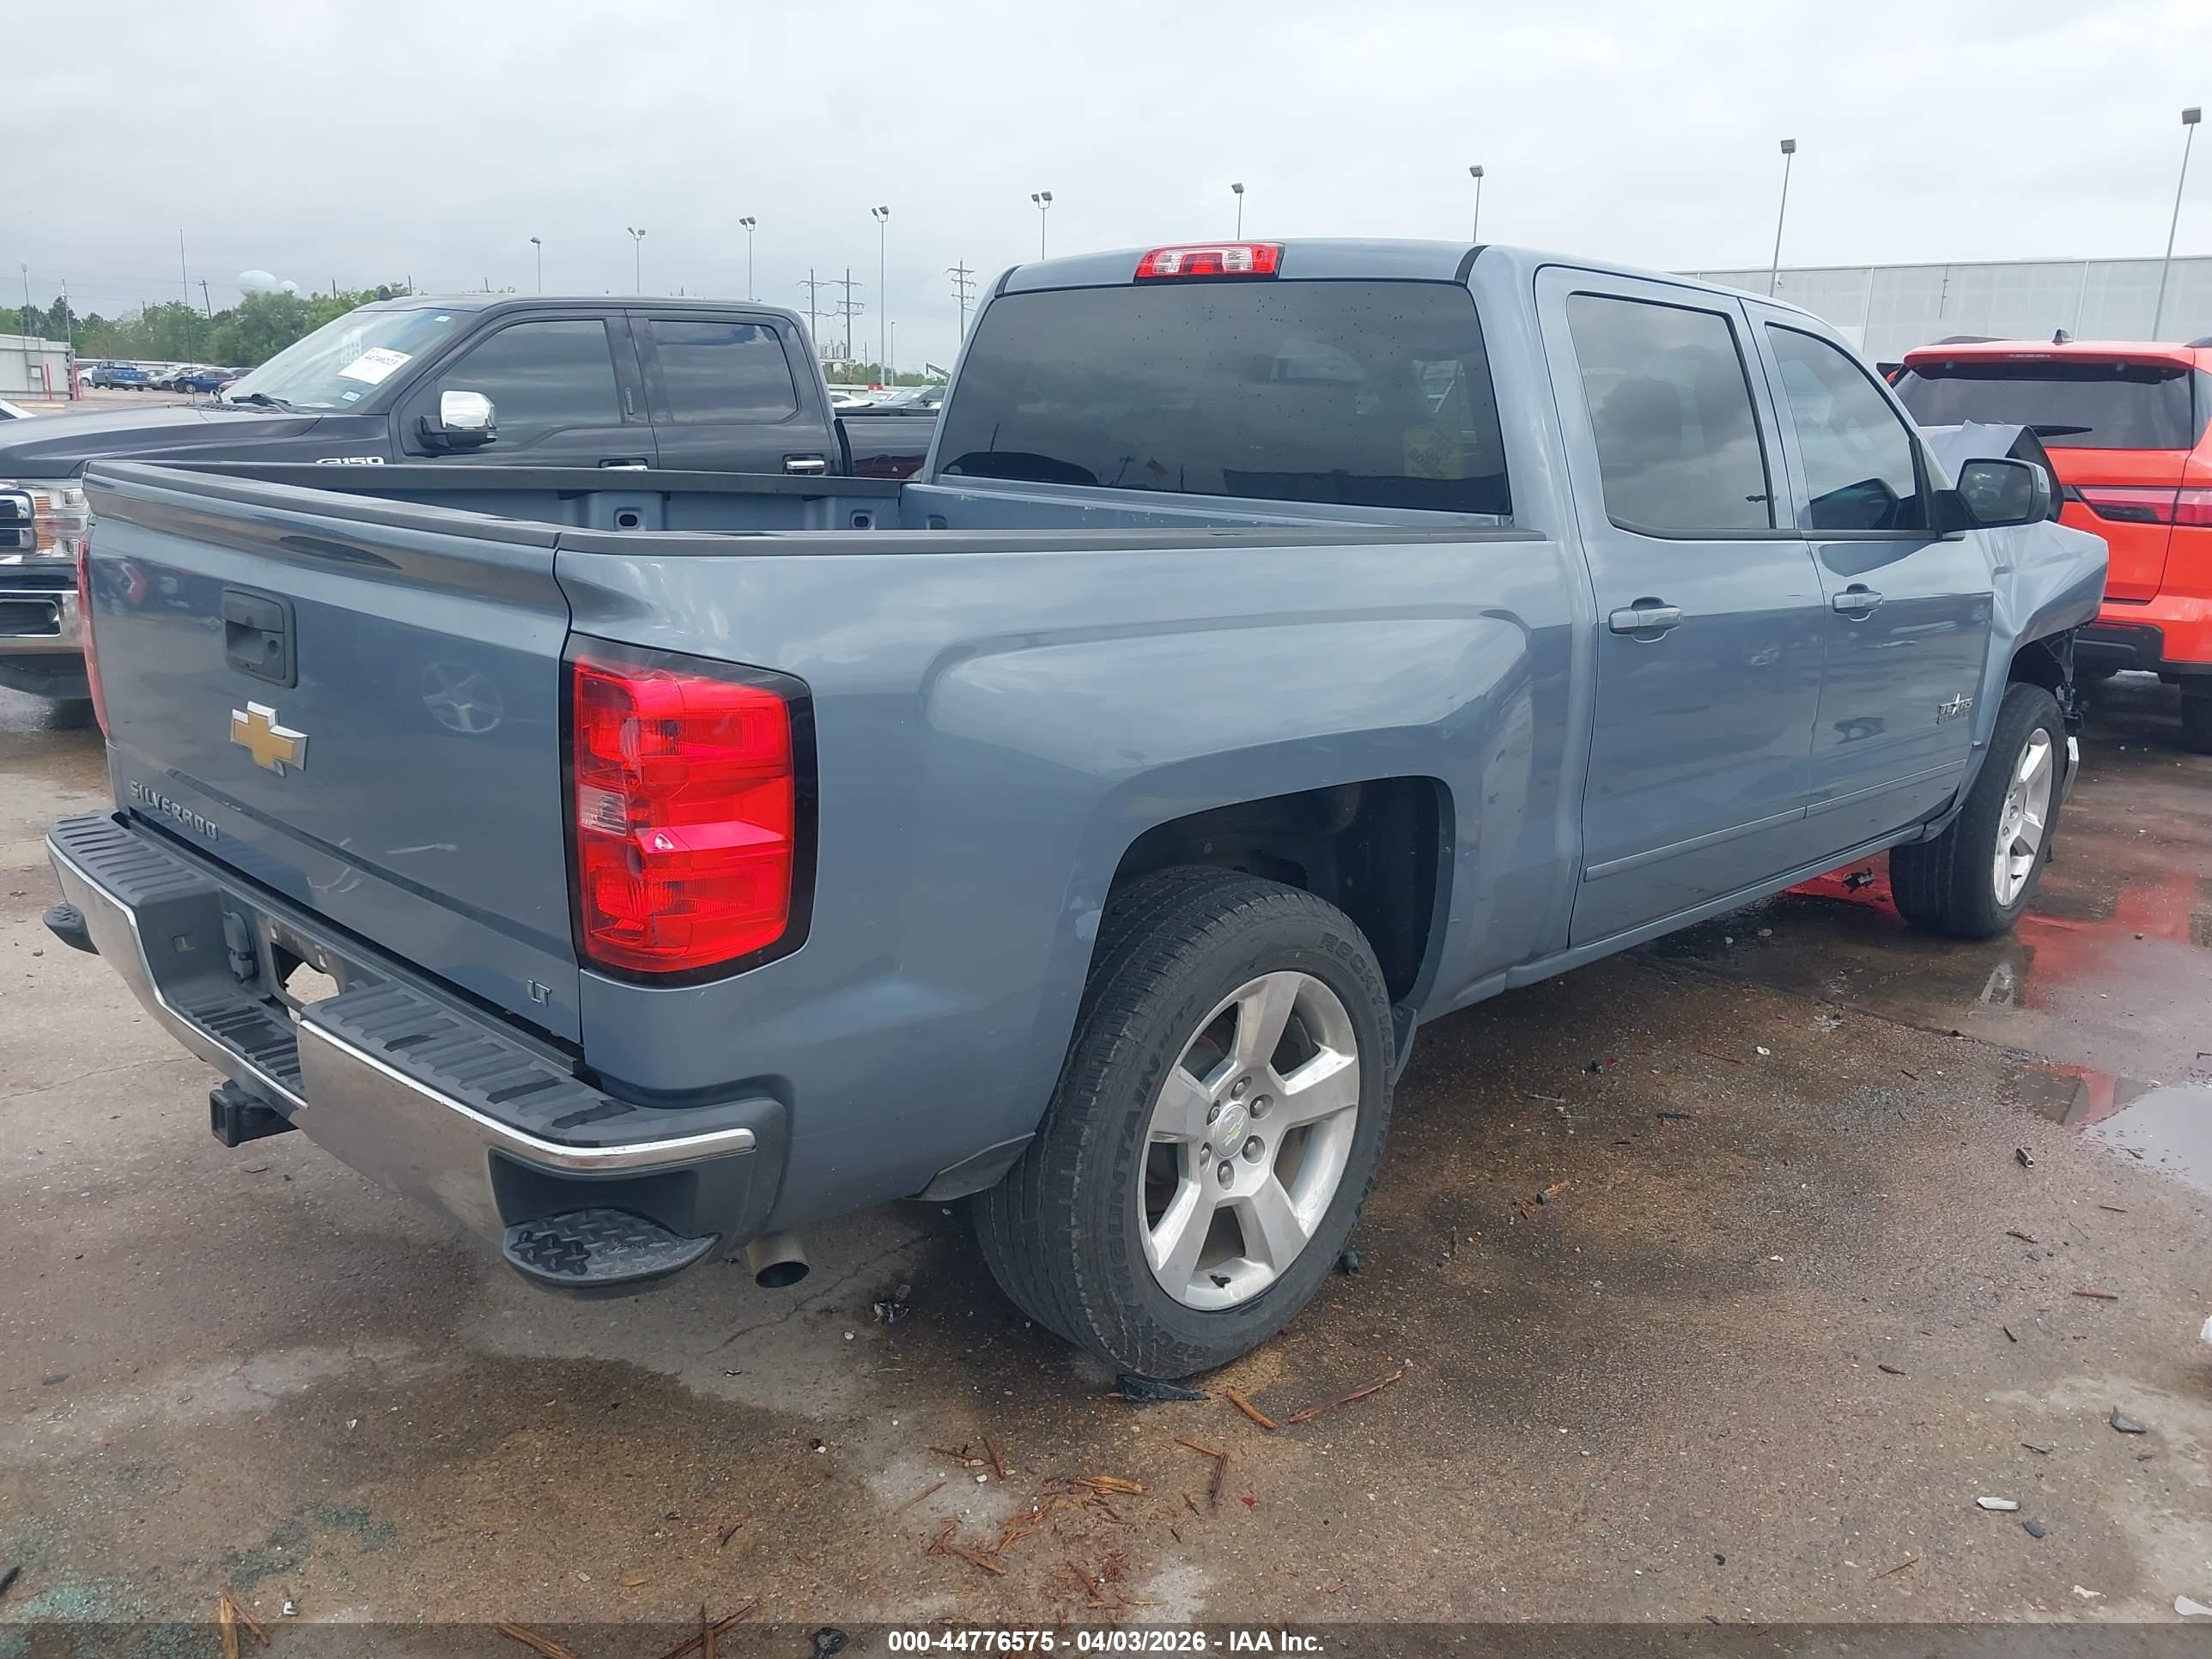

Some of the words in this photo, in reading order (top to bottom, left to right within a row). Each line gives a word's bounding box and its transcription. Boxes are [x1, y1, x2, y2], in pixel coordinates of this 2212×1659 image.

[130, 780, 219, 841] SILVERADO
[527, 979, 551, 1006] LT
[1318, 933, 1386, 1005] ROCKY
[1108, 1053, 1161, 1295] MOUNTAIN
